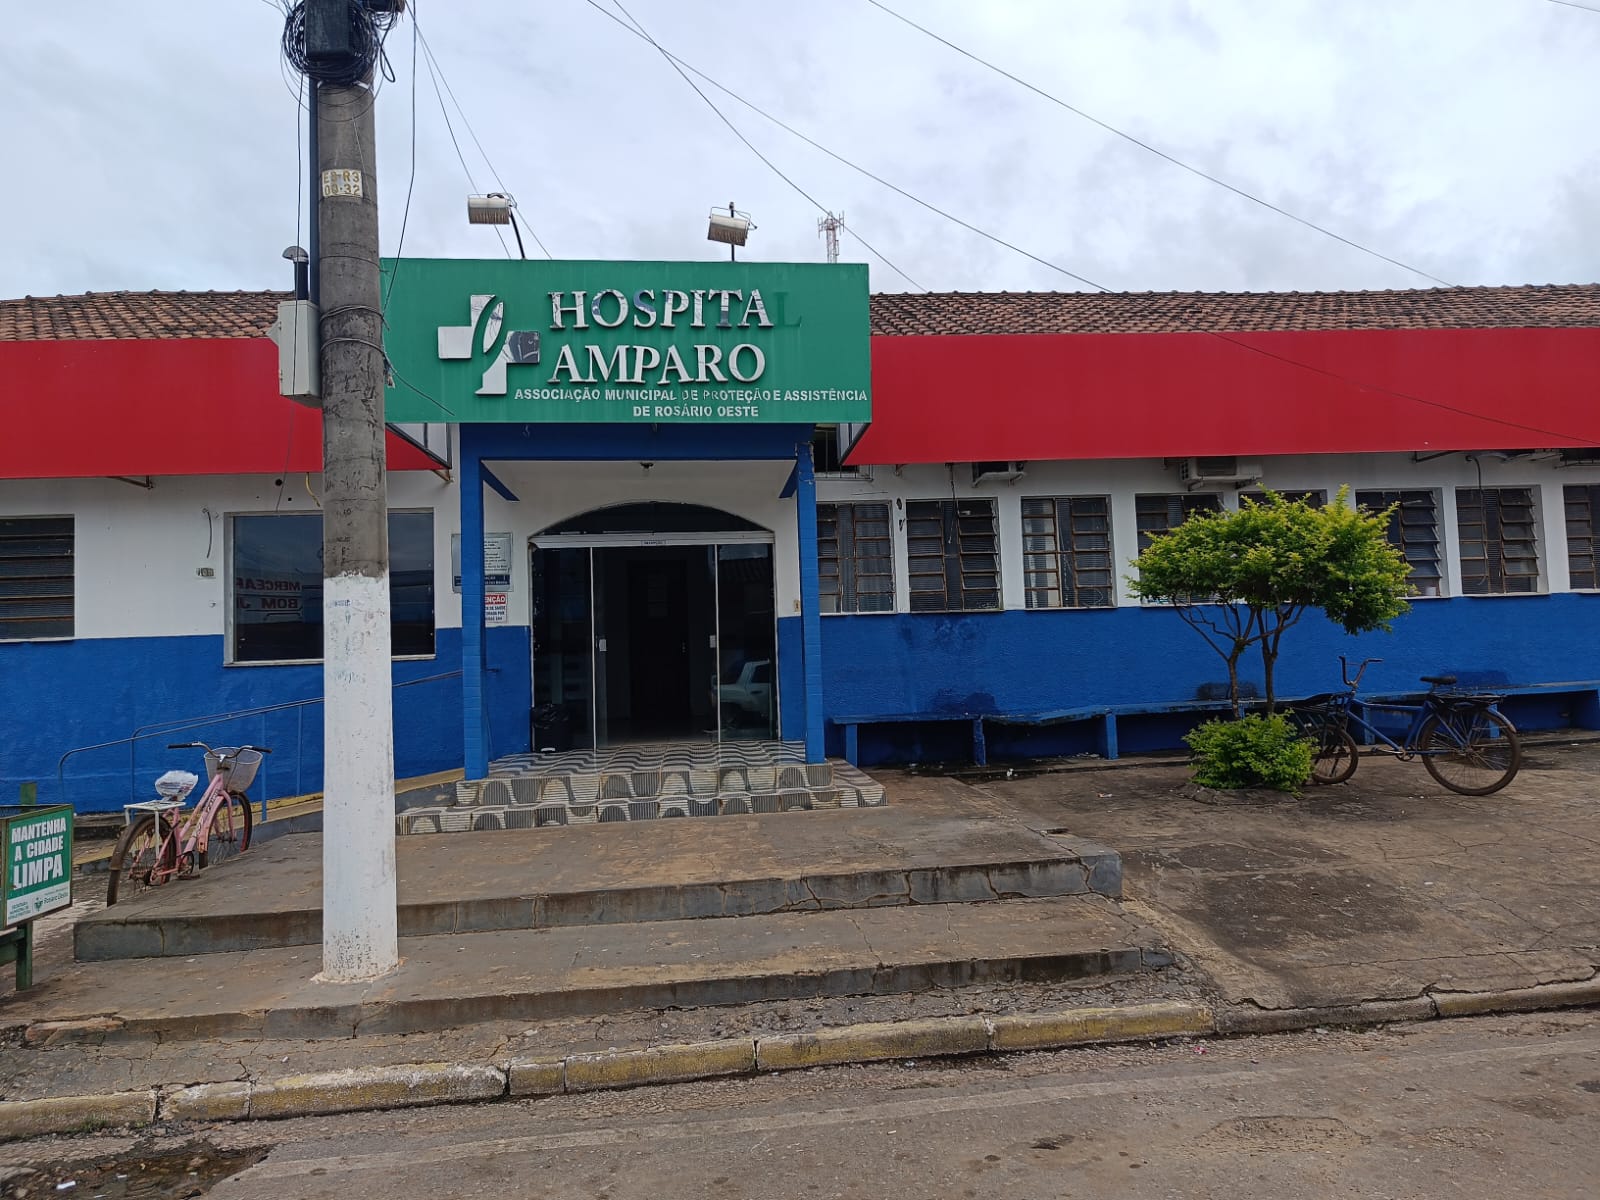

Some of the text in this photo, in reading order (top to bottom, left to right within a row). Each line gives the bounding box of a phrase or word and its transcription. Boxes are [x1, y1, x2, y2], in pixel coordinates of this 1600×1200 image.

[547, 343, 766, 384] AMPARO
[514, 387, 867, 403] ASSOCIAÇÃO MUNICIPAL DE PROTEÇÃO E ASSISTÊNCIA
[633, 403, 759, 417] DE ROSÁRIO OESTE
[12, 818, 66, 843] MANTENHA
[15, 836, 63, 861] A CIDADE
[14, 854, 63, 890] LIMPA
